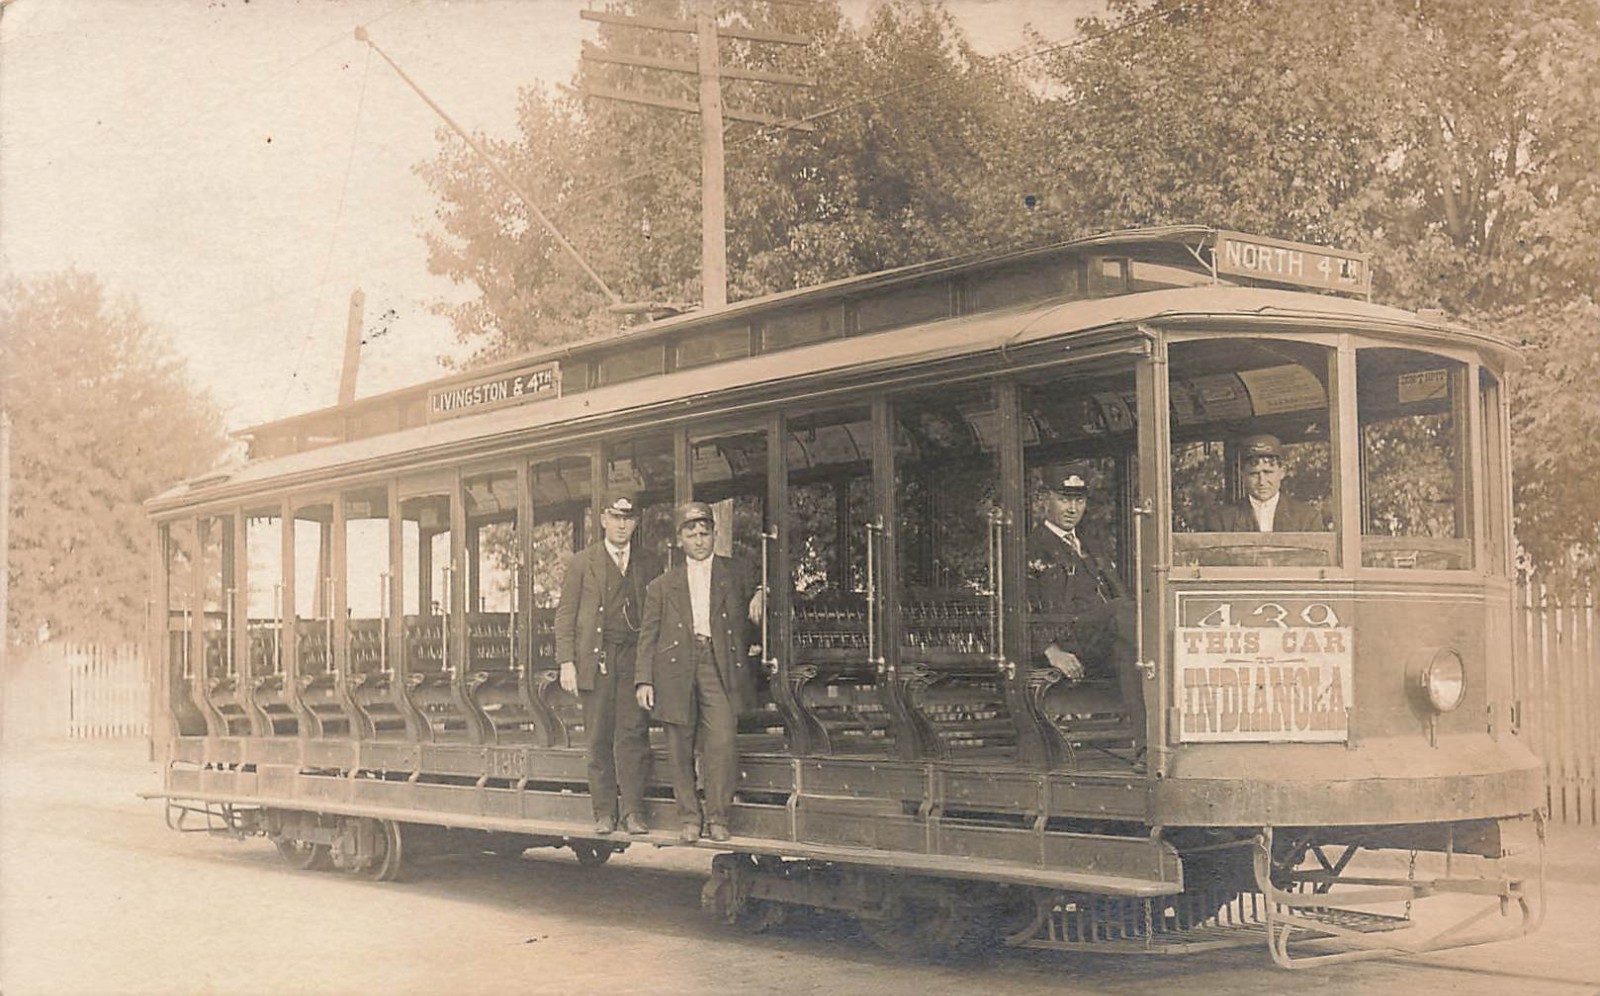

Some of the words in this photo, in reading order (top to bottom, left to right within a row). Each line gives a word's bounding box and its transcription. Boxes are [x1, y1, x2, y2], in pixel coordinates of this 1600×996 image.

[1225, 240, 1304, 277] NORTH
[432, 380, 507, 412] LIVINGSTON
[513, 376, 524, 396] &
[527, 370, 552, 393] 4TH
[1198, 602, 1339, 628] 439
[1183, 632, 1260, 654] THIS
[1282, 631, 1346, 653] CAR
[1183, 666, 1346, 733] INDIANOLA
